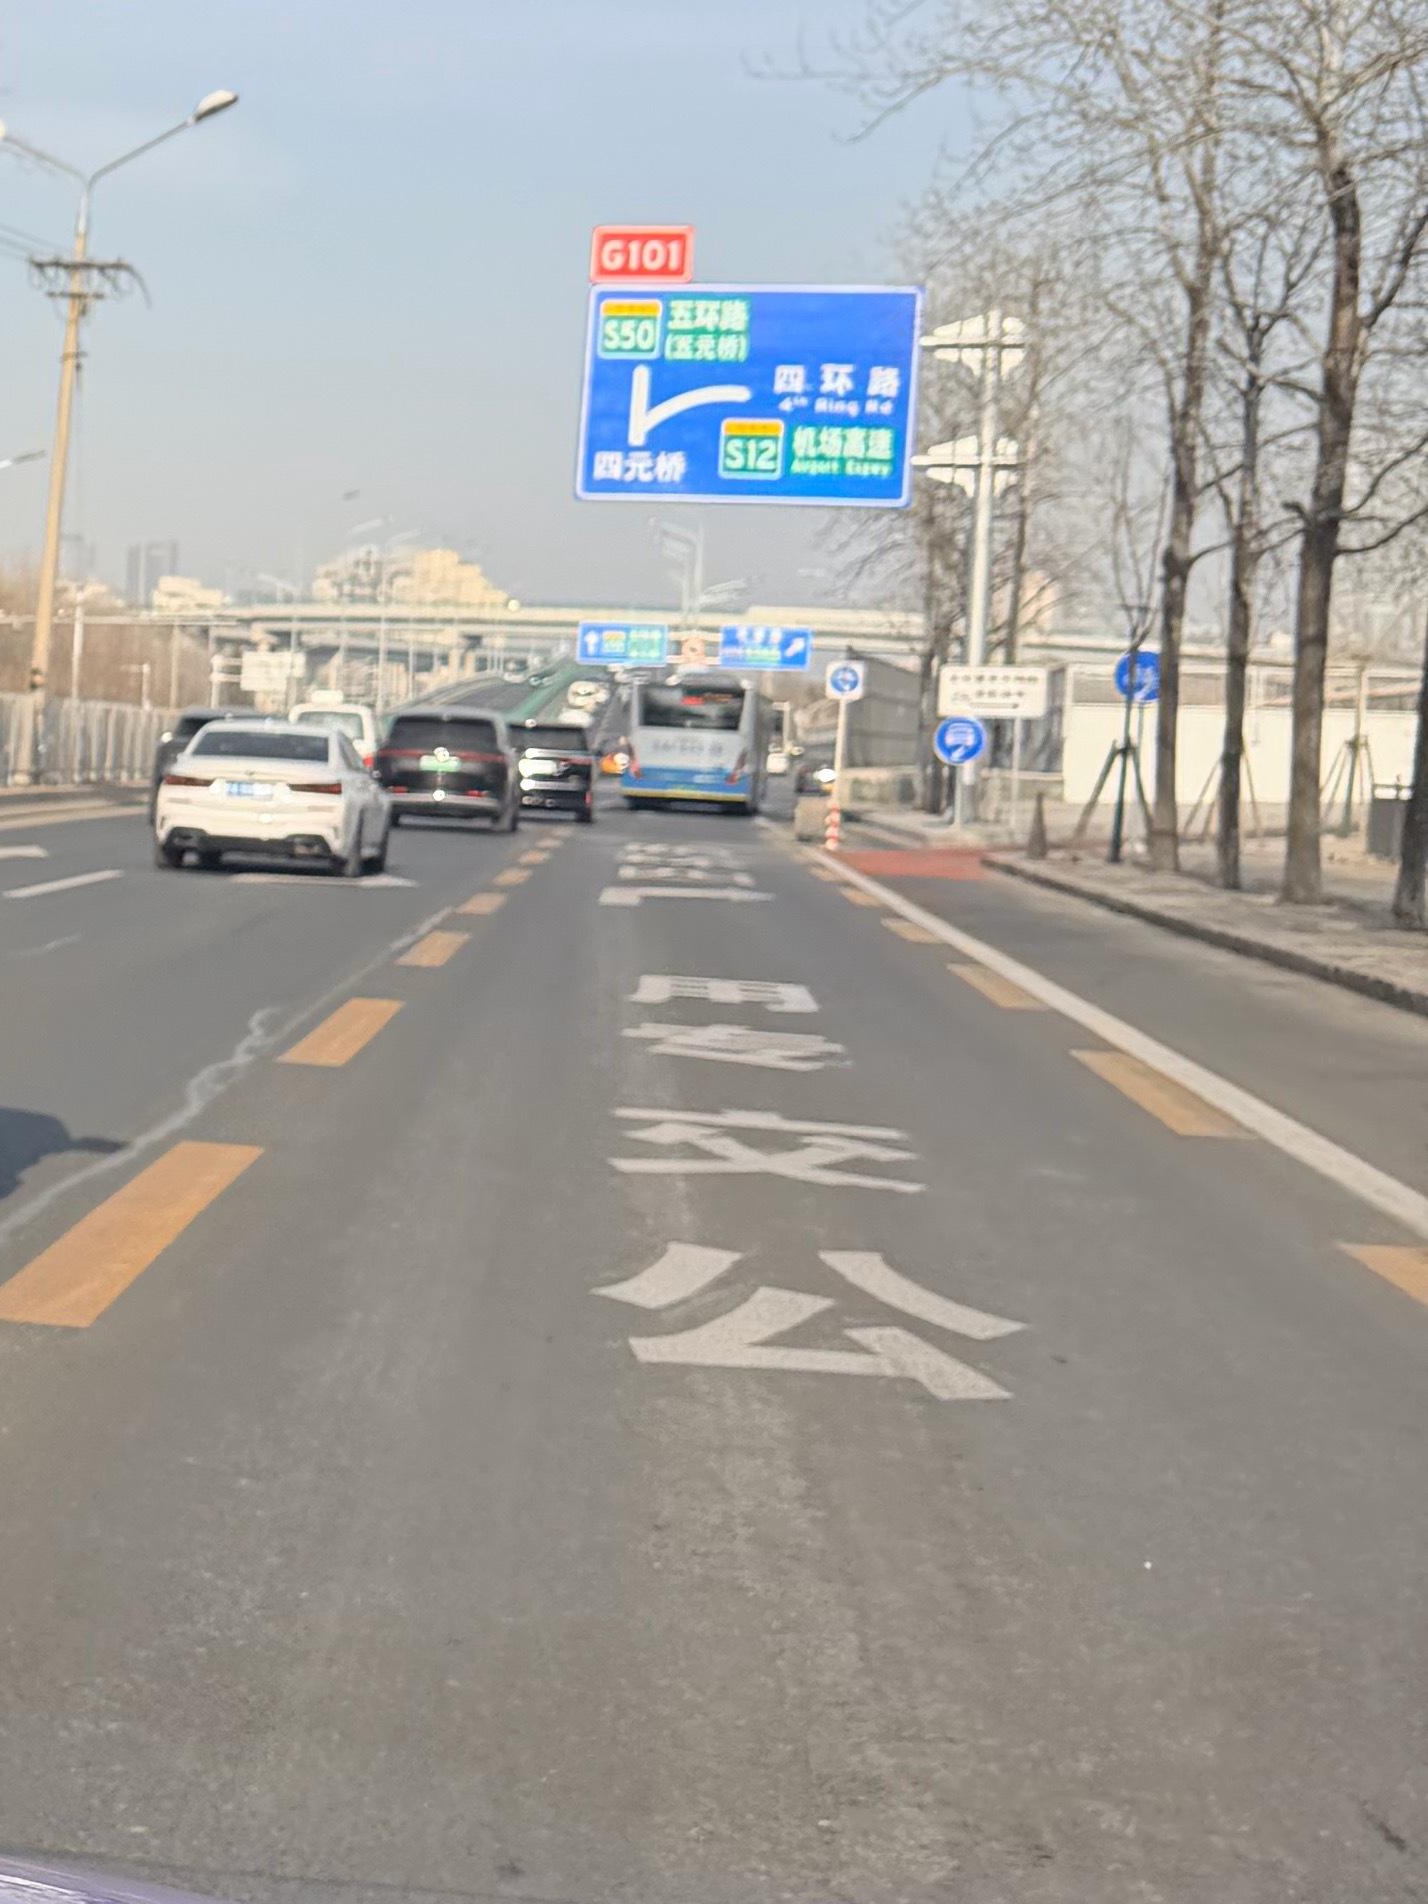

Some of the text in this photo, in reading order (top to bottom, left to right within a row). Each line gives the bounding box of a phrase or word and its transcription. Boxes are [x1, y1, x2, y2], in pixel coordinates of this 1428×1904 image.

[602, 239, 681, 271] G101
[667, 299, 749, 332] 五环路
[603, 319, 655, 351] S50
[773, 363, 900, 397] 四环路
[813, 397, 860, 417] Ring
[864, 398, 893, 415] Rd
[593, 451, 686, 484] 四元桥
[724, 438, 777, 470] S12
